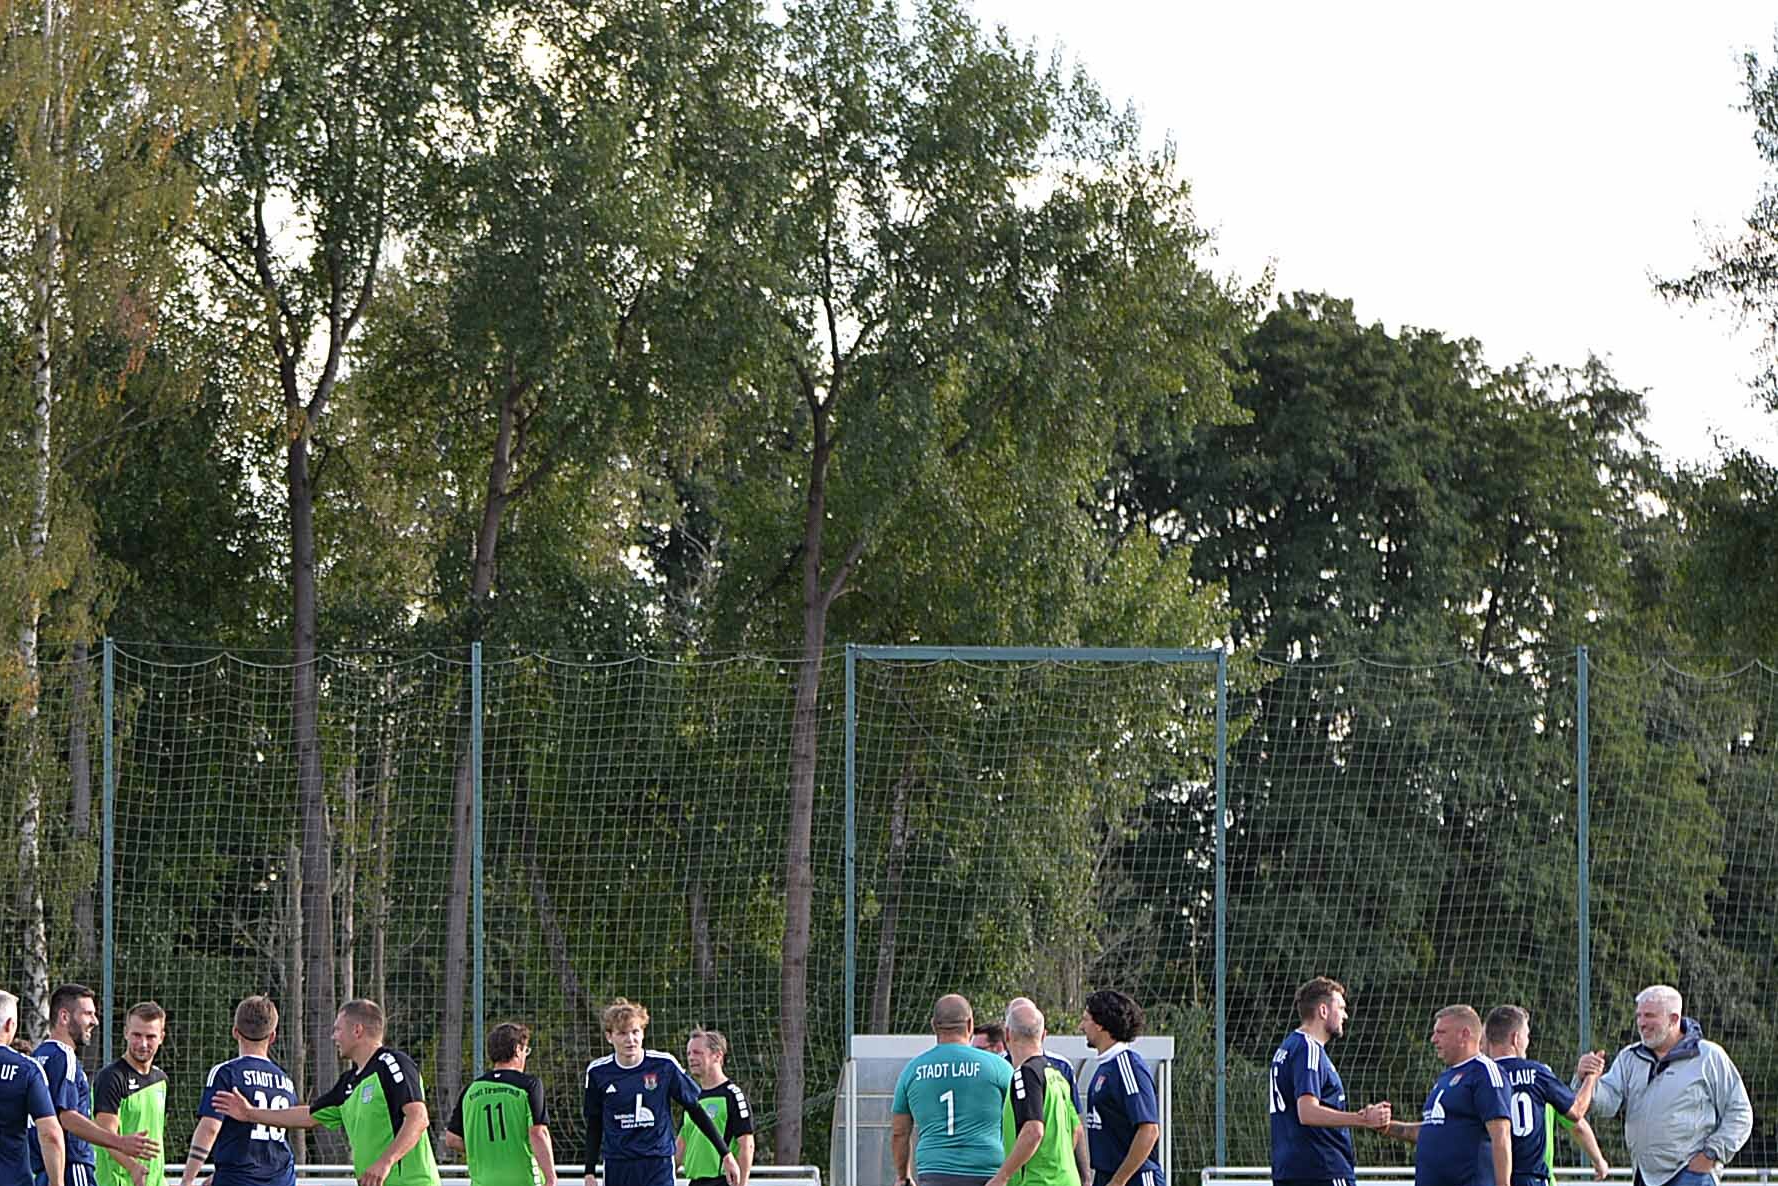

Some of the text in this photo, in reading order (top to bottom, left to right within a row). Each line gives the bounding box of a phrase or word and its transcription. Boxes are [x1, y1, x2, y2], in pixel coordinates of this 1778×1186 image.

[243, 1070, 273, 1088] STADT
[915, 1062, 981, 1080] STADT LAUF
[1509, 1068, 1537, 1086] LAUF
[483, 1102, 506, 1142] 11
[939, 1089, 954, 1136] 1
[1510, 1091, 1534, 1137] 0
